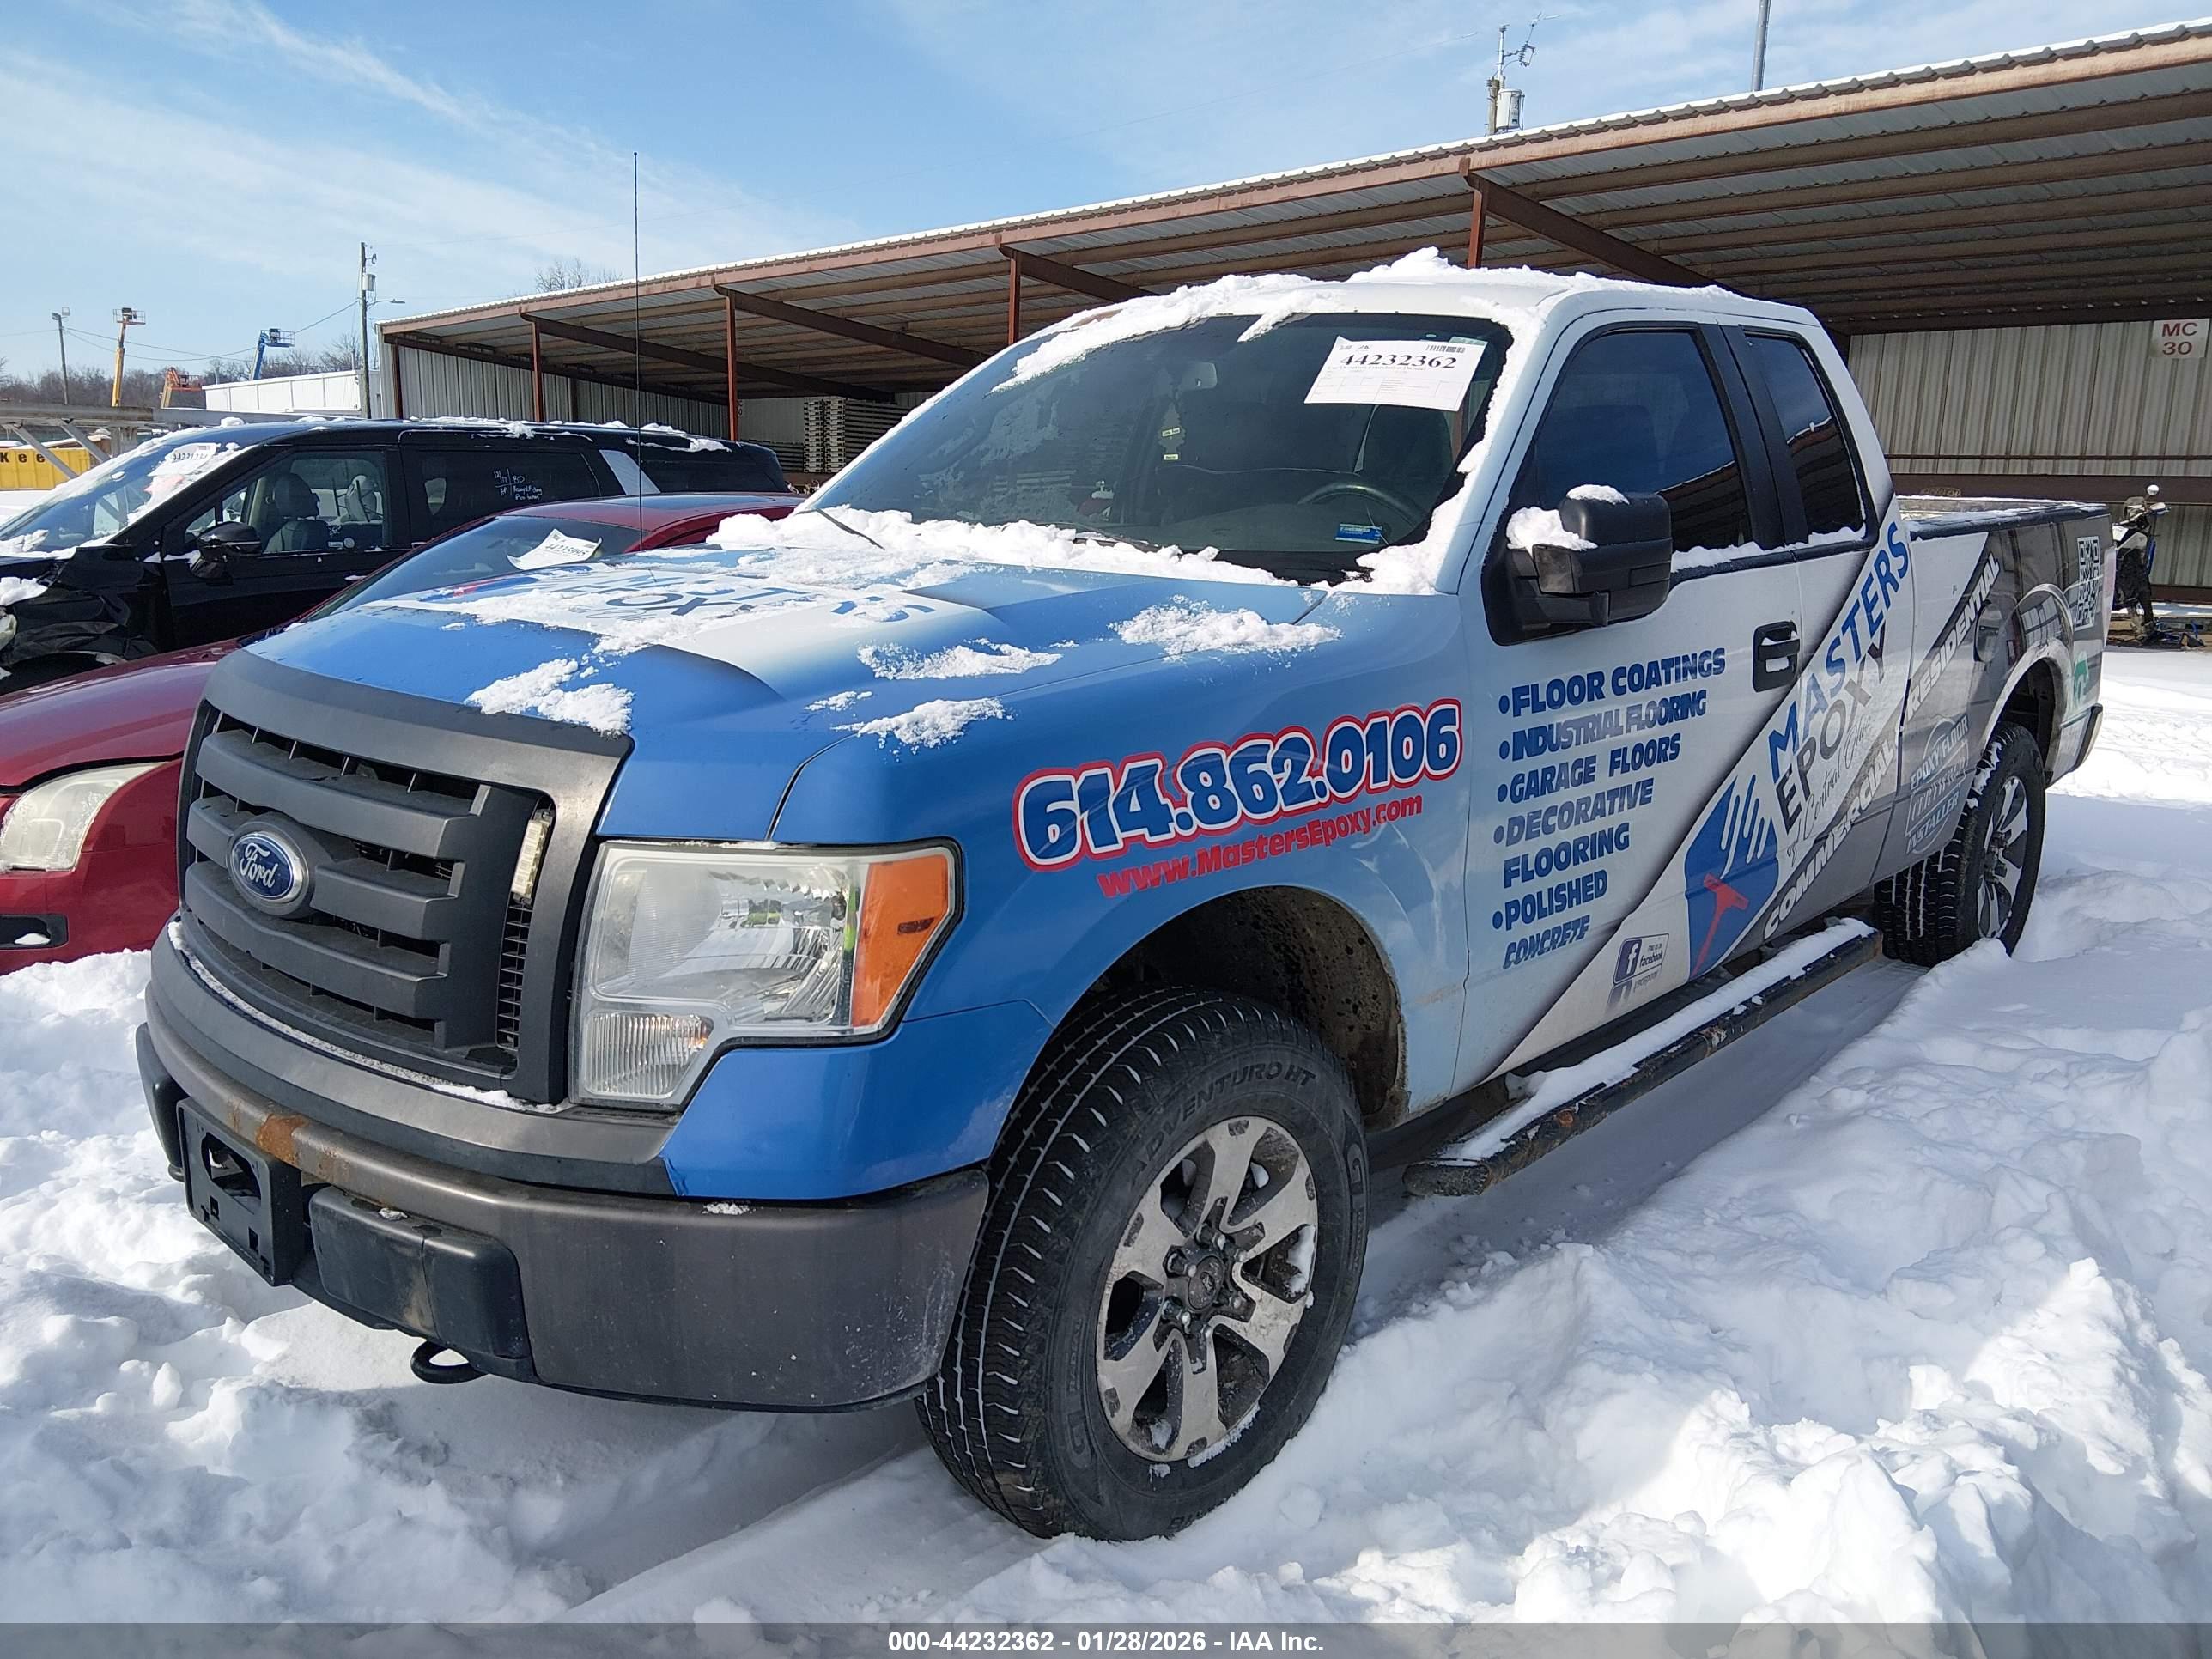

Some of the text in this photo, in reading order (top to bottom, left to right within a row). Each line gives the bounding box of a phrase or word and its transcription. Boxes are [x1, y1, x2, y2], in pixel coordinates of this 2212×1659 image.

[1340, 353, 1458, 370] 44232362
[2161, 322, 2198, 337] MC
[2161, 341, 2193, 356] 30
[1769, 521, 1909, 784] MASTERS
[1906, 552, 2001, 722] RESIDENTIAL
[1511, 647, 1726, 718] FLOOR COATINGS
[1511, 689, 1707, 762] INDUSTRIAL FLOORING
[1775, 619, 1887, 836] EPOXY
[1910, 714, 1970, 792] EPOXY FLOOR
[1014, 700, 1462, 870] 614.862.0106
[1510, 732, 1680, 803] GARAGE FLOORS
[1097, 792, 1423, 899] www.MastersEpoxy.com
[1505, 778, 1654, 848] DECORATIVE
[1763, 739, 1894, 940] COMMERCIAL
[1906, 789, 1961, 855] INSTALLER
[240, 842, 279, 888] Ford
[1504, 822, 1630, 890] FLOORING
[1504, 869, 1607, 932] POLISHED
[1503, 914, 1590, 969] CONCRETE
